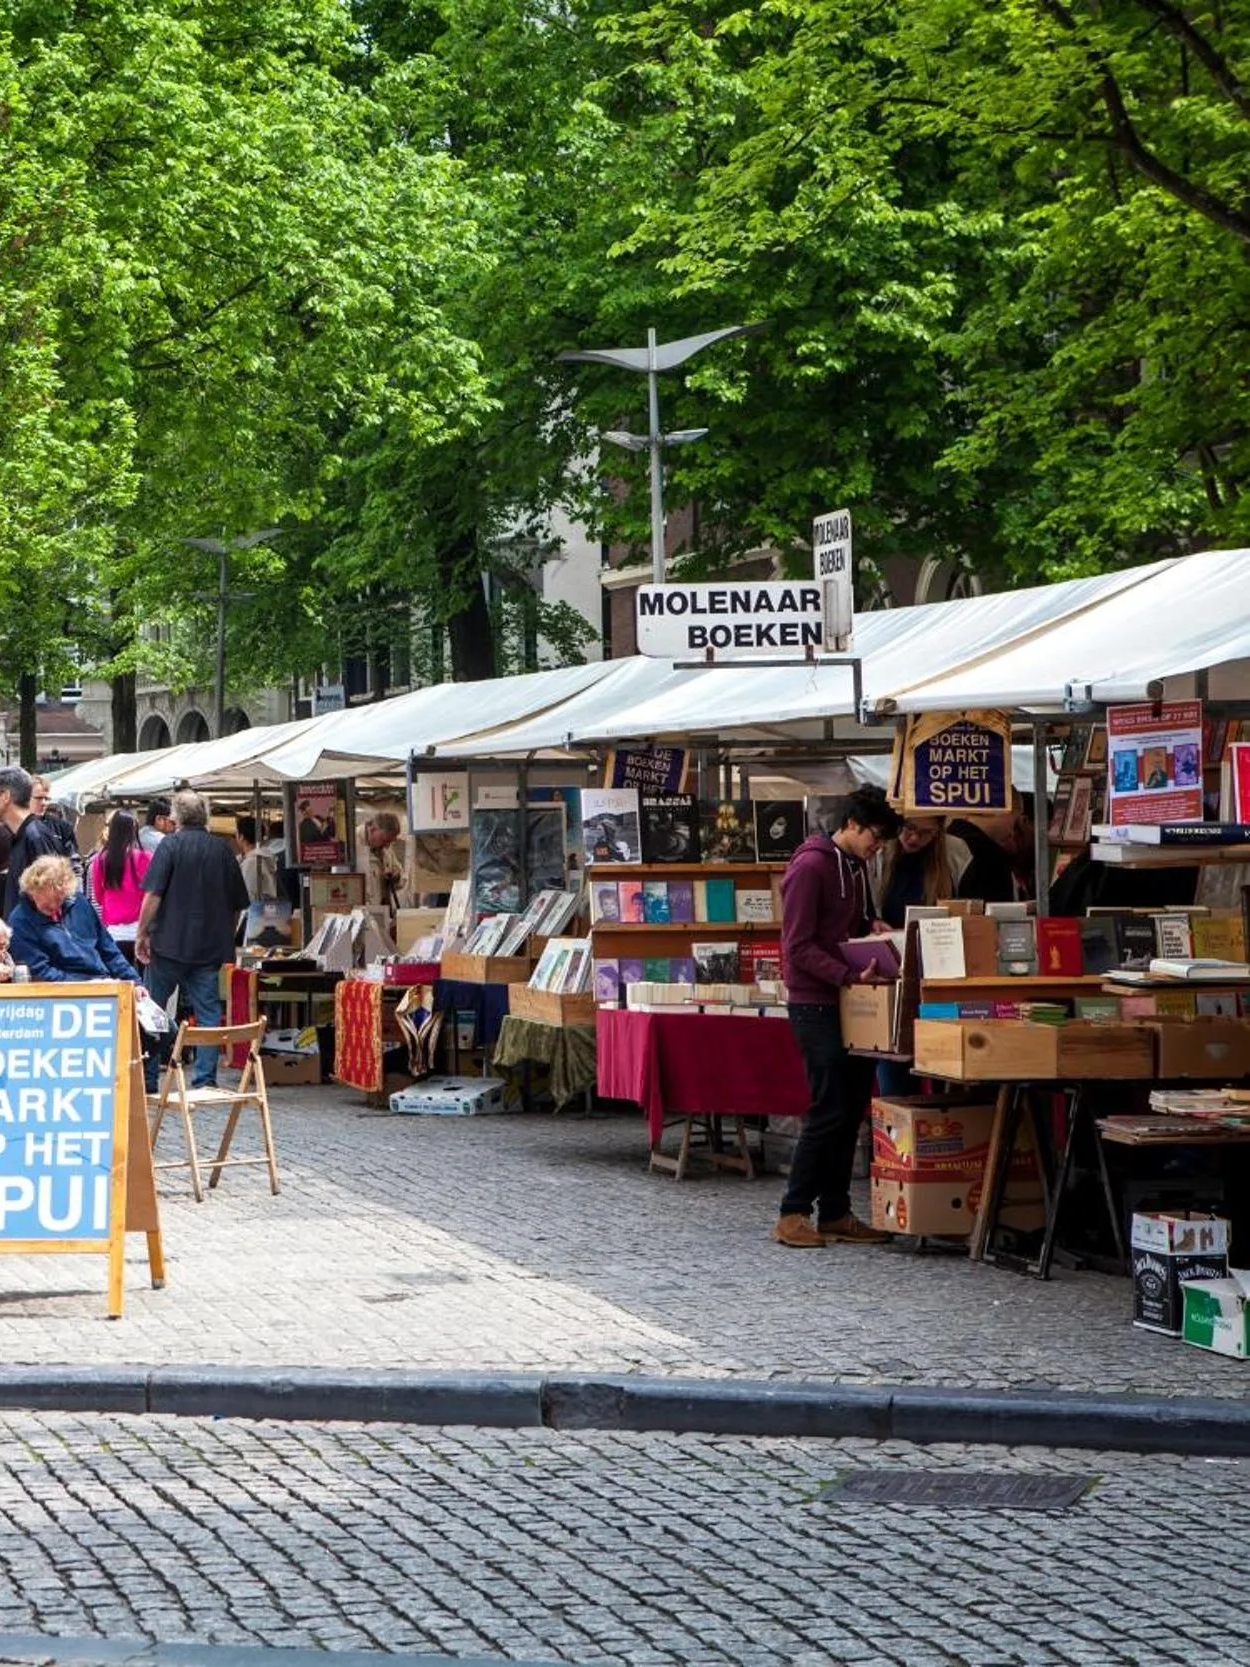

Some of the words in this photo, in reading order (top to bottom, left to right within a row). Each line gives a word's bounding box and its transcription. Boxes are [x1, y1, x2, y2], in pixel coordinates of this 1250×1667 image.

[820, 548, 846, 576] BOEKEN
[639, 588, 821, 616] MOLENAAR
[687, 621, 823, 649] BOEKEN
[626, 754, 671, 772] BOEKEN
[929, 749, 990, 763] MARKT
[625, 765, 670, 784] MARKT
[929, 765, 952, 779] OP
[958, 766, 990, 779] HET
[929, 781, 990, 805] SPUI
[51, 1003, 113, 1039] DE
[25, 1131, 111, 1166] HET
